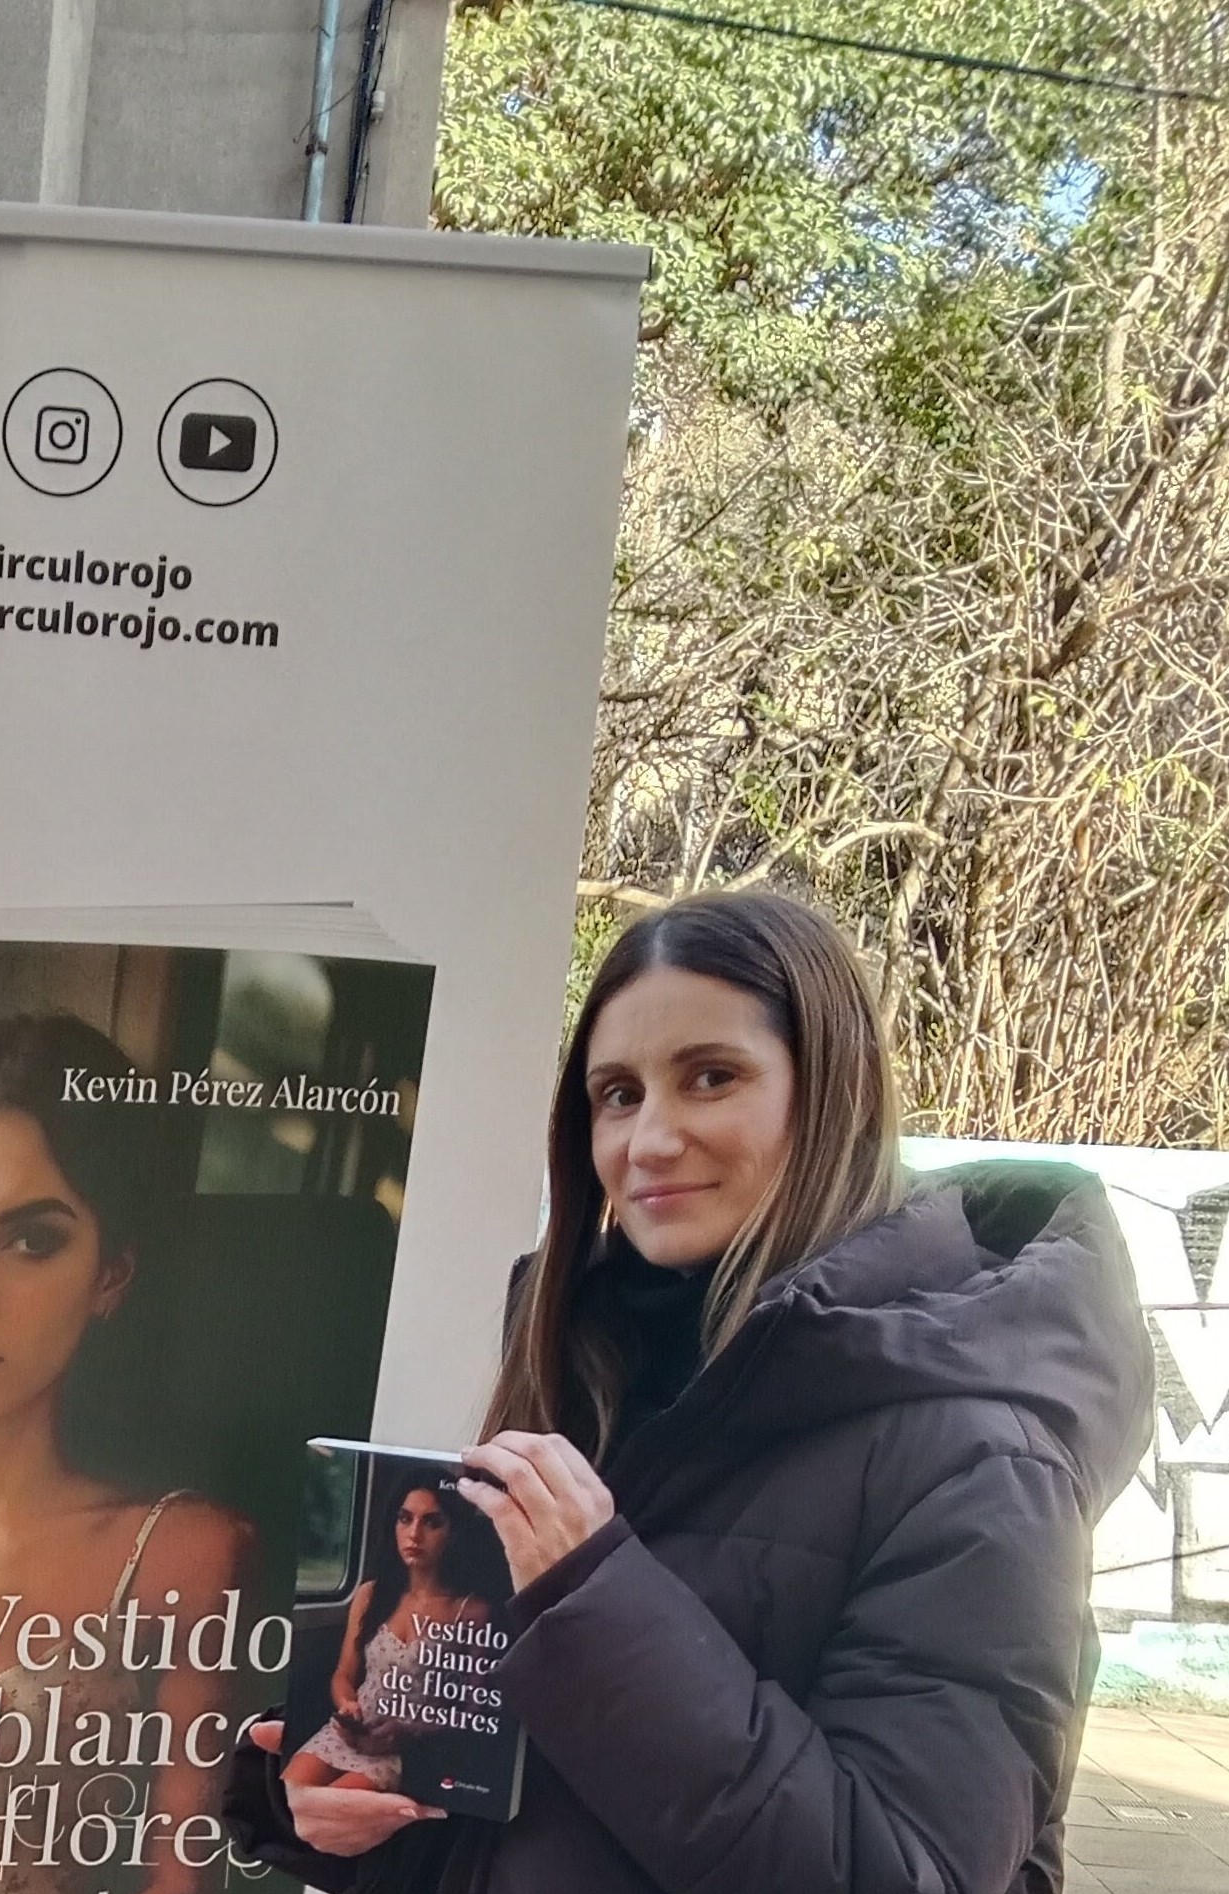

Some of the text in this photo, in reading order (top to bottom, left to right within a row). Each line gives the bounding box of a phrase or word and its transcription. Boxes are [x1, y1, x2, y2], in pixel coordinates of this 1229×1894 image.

[60, 1067, 400, 1116] Kevin Pérez Alarcón
[411, 1613, 509, 1650] Vestido
[382, 1666, 502, 1707] de flores
[377, 1693, 500, 1735] silvestres
